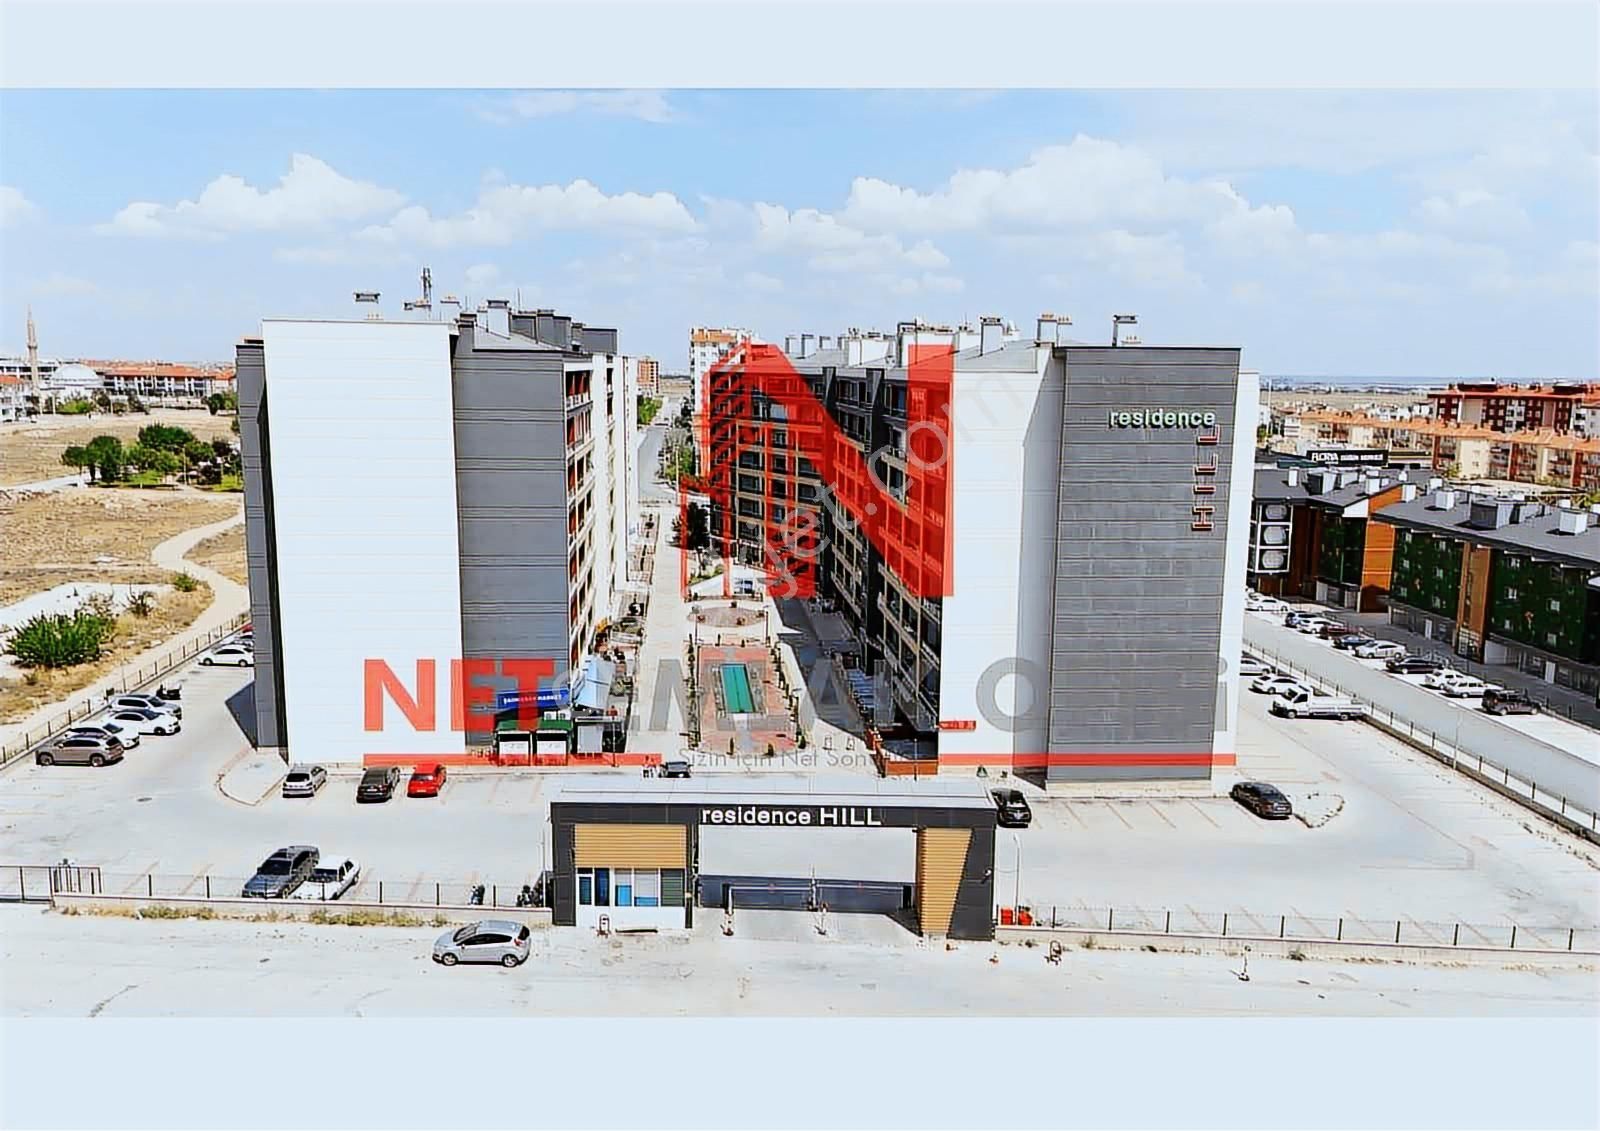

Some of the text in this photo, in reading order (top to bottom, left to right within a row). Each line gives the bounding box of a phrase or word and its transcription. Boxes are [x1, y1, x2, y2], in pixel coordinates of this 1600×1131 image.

[1109, 408, 1216, 427] residence
[1192, 424, 1220, 531] HILL
[702, 806, 882, 826] residence HILL
